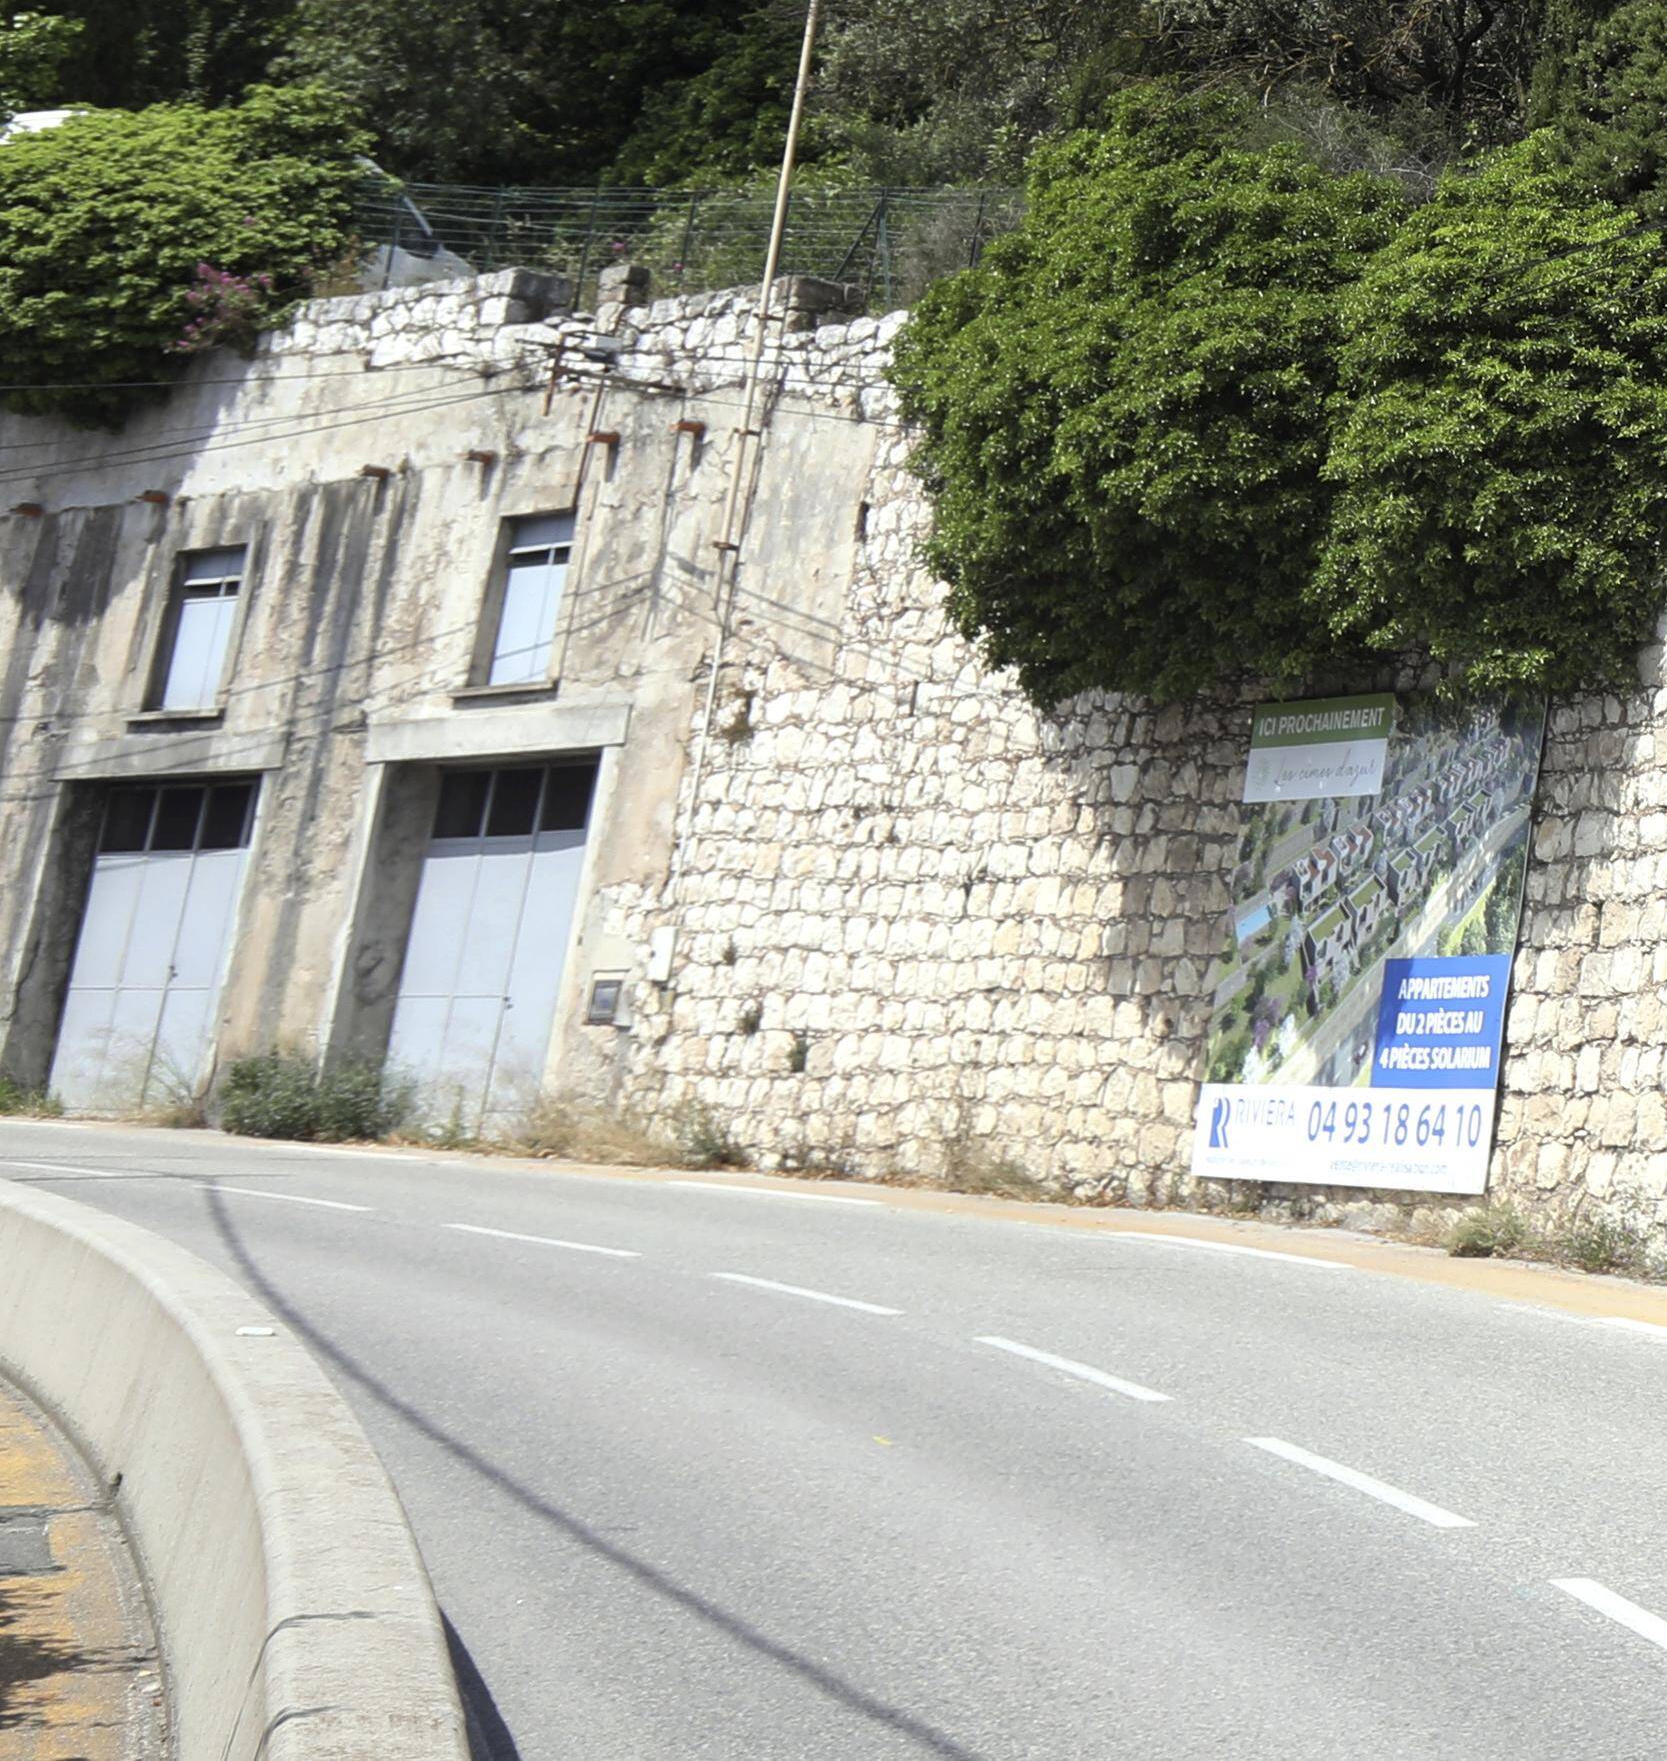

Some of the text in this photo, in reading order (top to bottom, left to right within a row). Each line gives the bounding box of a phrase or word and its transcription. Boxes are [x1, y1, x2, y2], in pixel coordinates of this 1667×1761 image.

[1259, 707, 1386, 737] ICI PROCHAINEMENT
[1398, 974, 1491, 1000] APPARTEMENTS
[1396, 1006, 1484, 1035] DU 2 PIÈCES AU
[1379, 1042, 1492, 1070] 4 PIÈCES SOLARIUM
[1235, 1098, 1295, 1127] RIVIERA
[1307, 1100, 1482, 1148] 04 93 18 64 10
